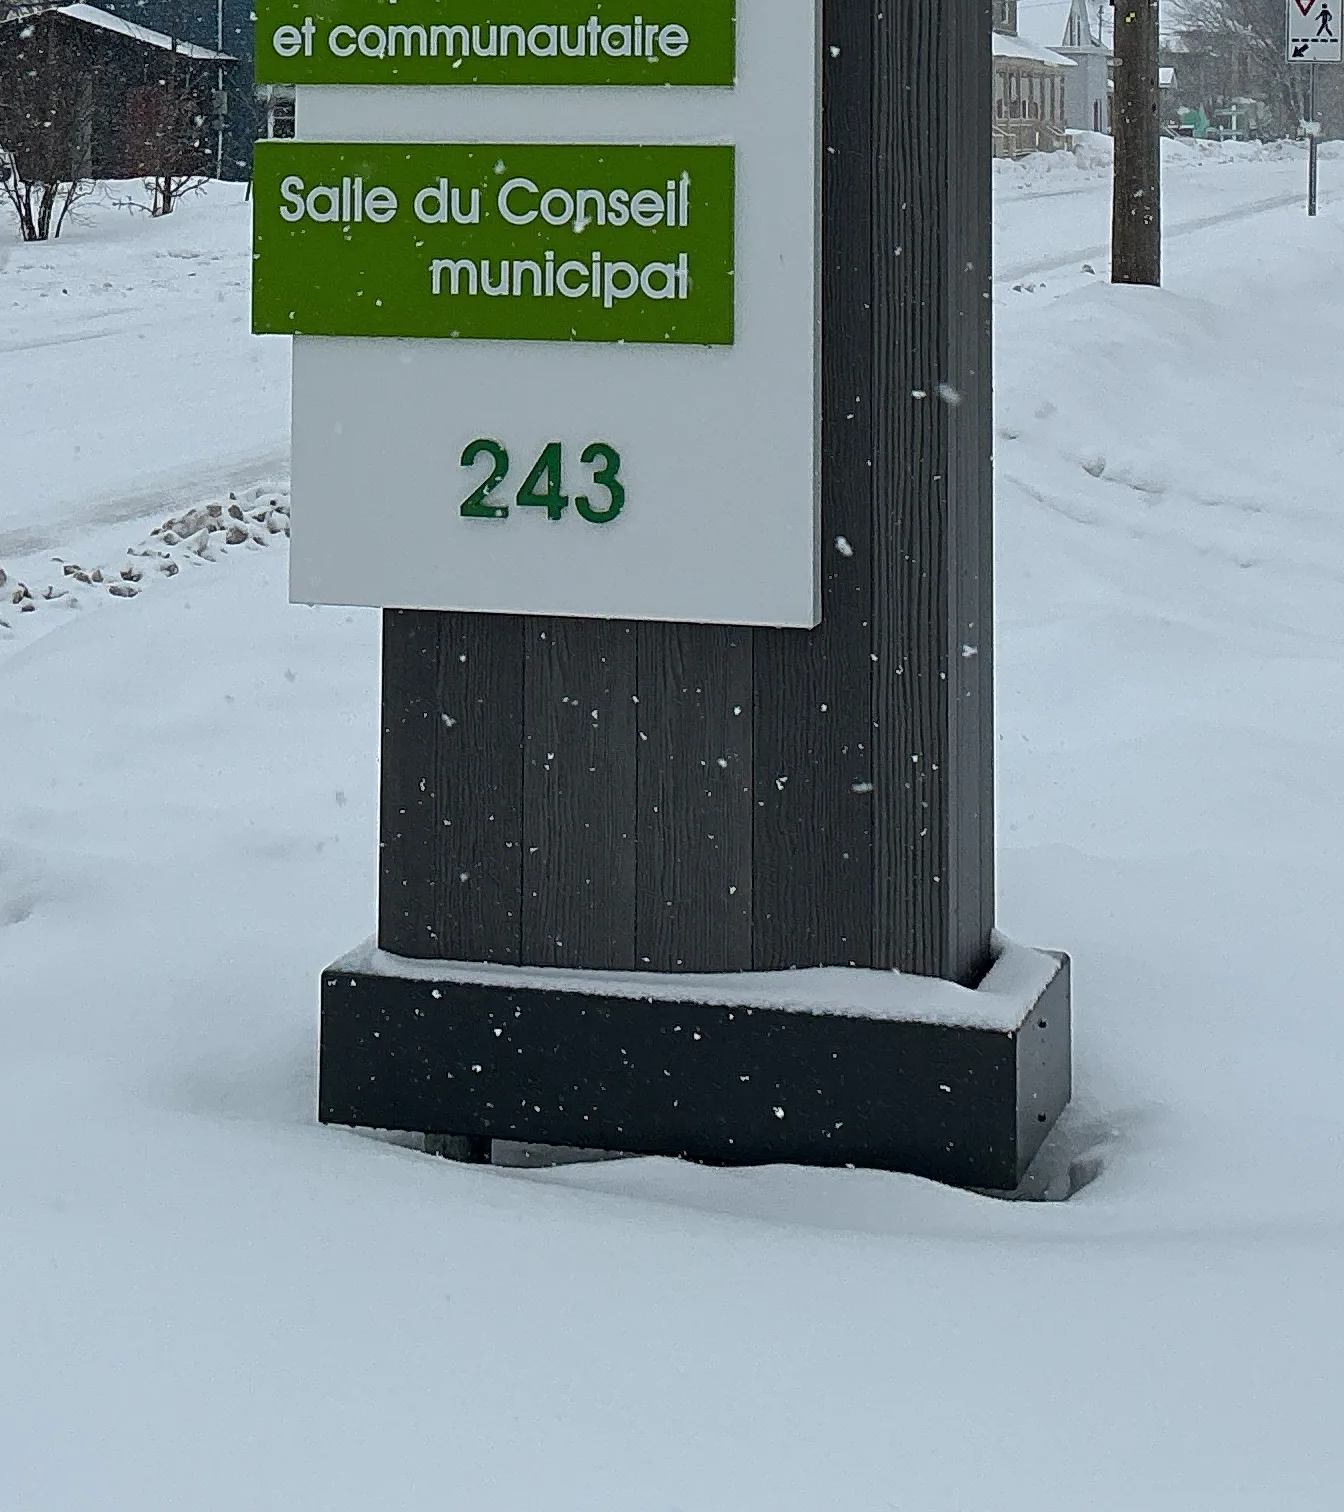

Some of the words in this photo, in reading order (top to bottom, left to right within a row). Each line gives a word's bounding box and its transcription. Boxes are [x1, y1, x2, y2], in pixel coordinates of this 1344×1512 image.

[271, 16, 315, 58] et
[327, 15, 690, 58] communautaire
[278, 175, 398, 224] Salle
[413, 178, 481, 225] du
[496, 177, 689, 228] Conseil
[429, 250, 689, 309] municipal
[459, 438, 626, 524] 243
